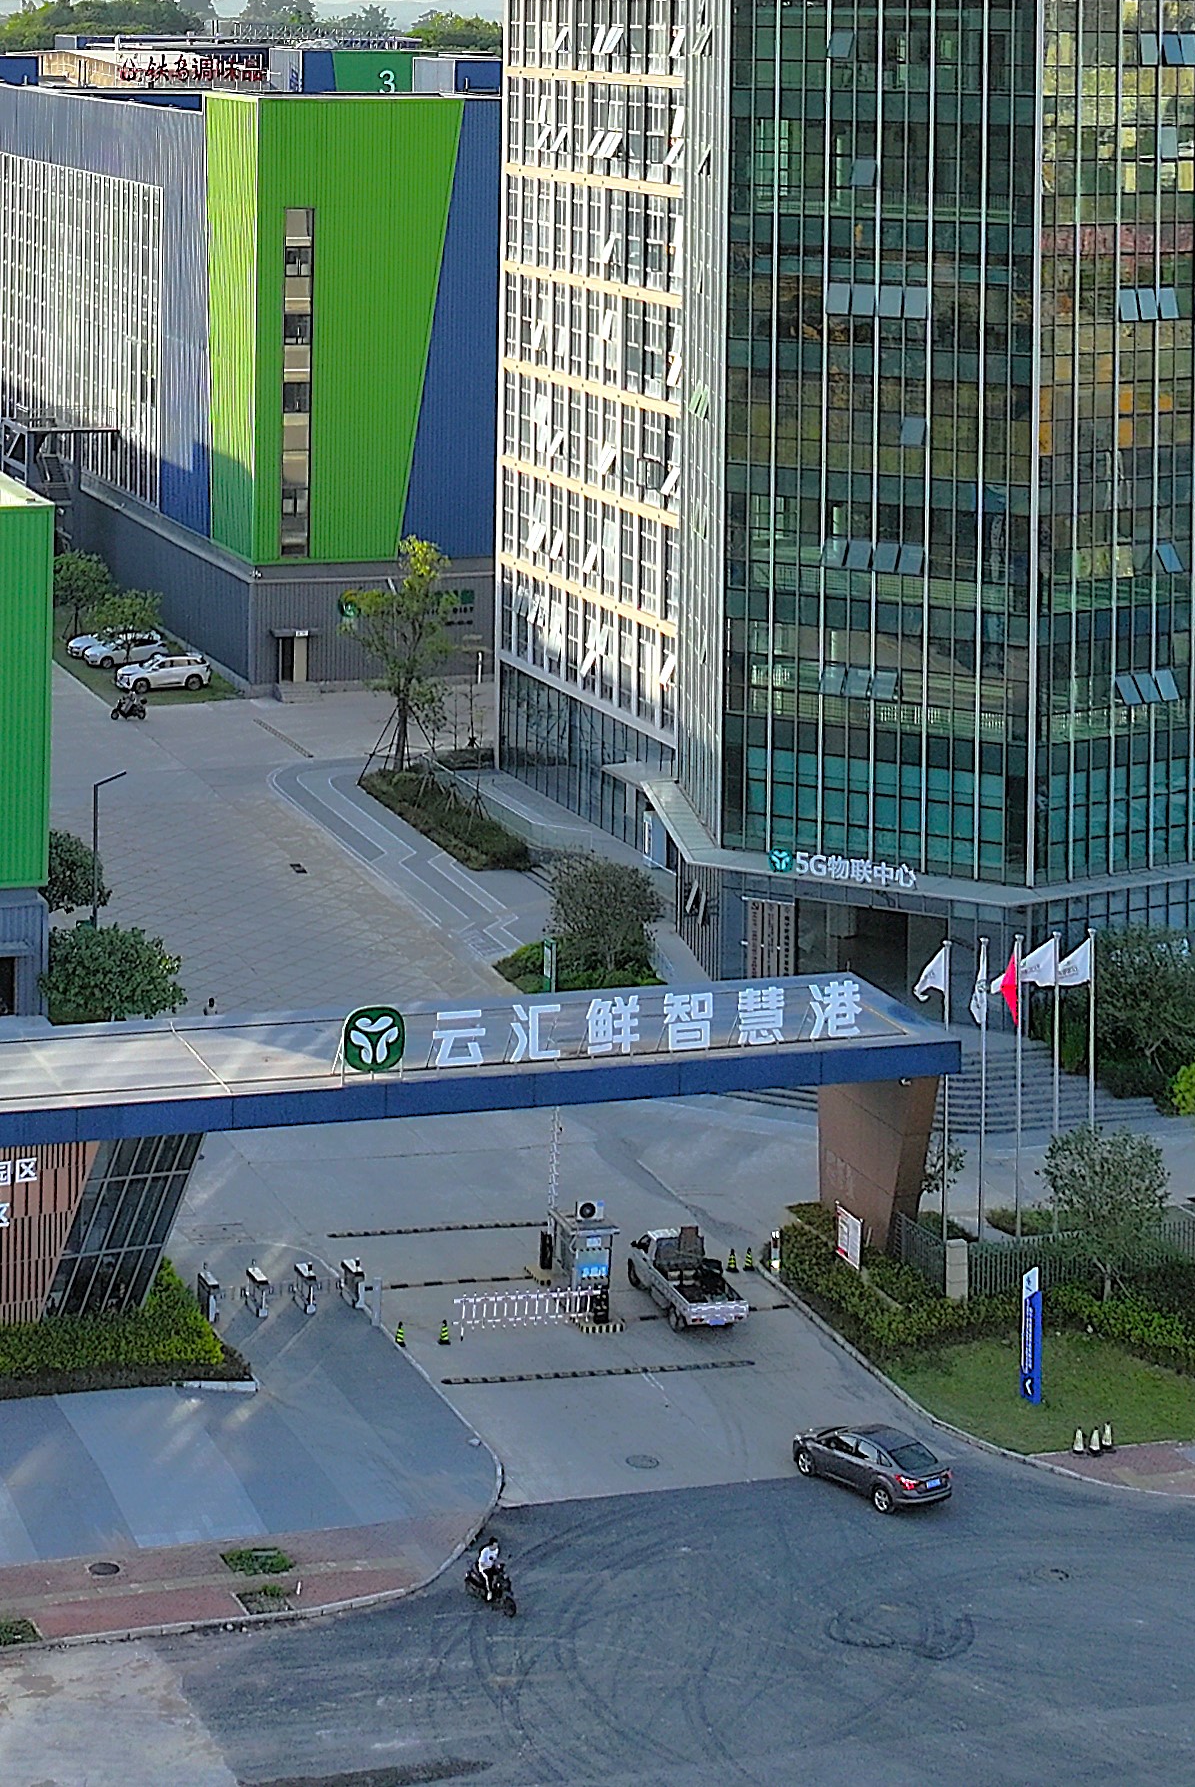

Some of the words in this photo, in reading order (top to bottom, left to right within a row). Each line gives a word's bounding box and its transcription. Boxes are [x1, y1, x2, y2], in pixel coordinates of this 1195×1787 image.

[379, 70, 395, 93] 3
[796, 852, 917, 888] 5G物联中心
[432, 980, 863, 1067] 云汇鲜智慧港
